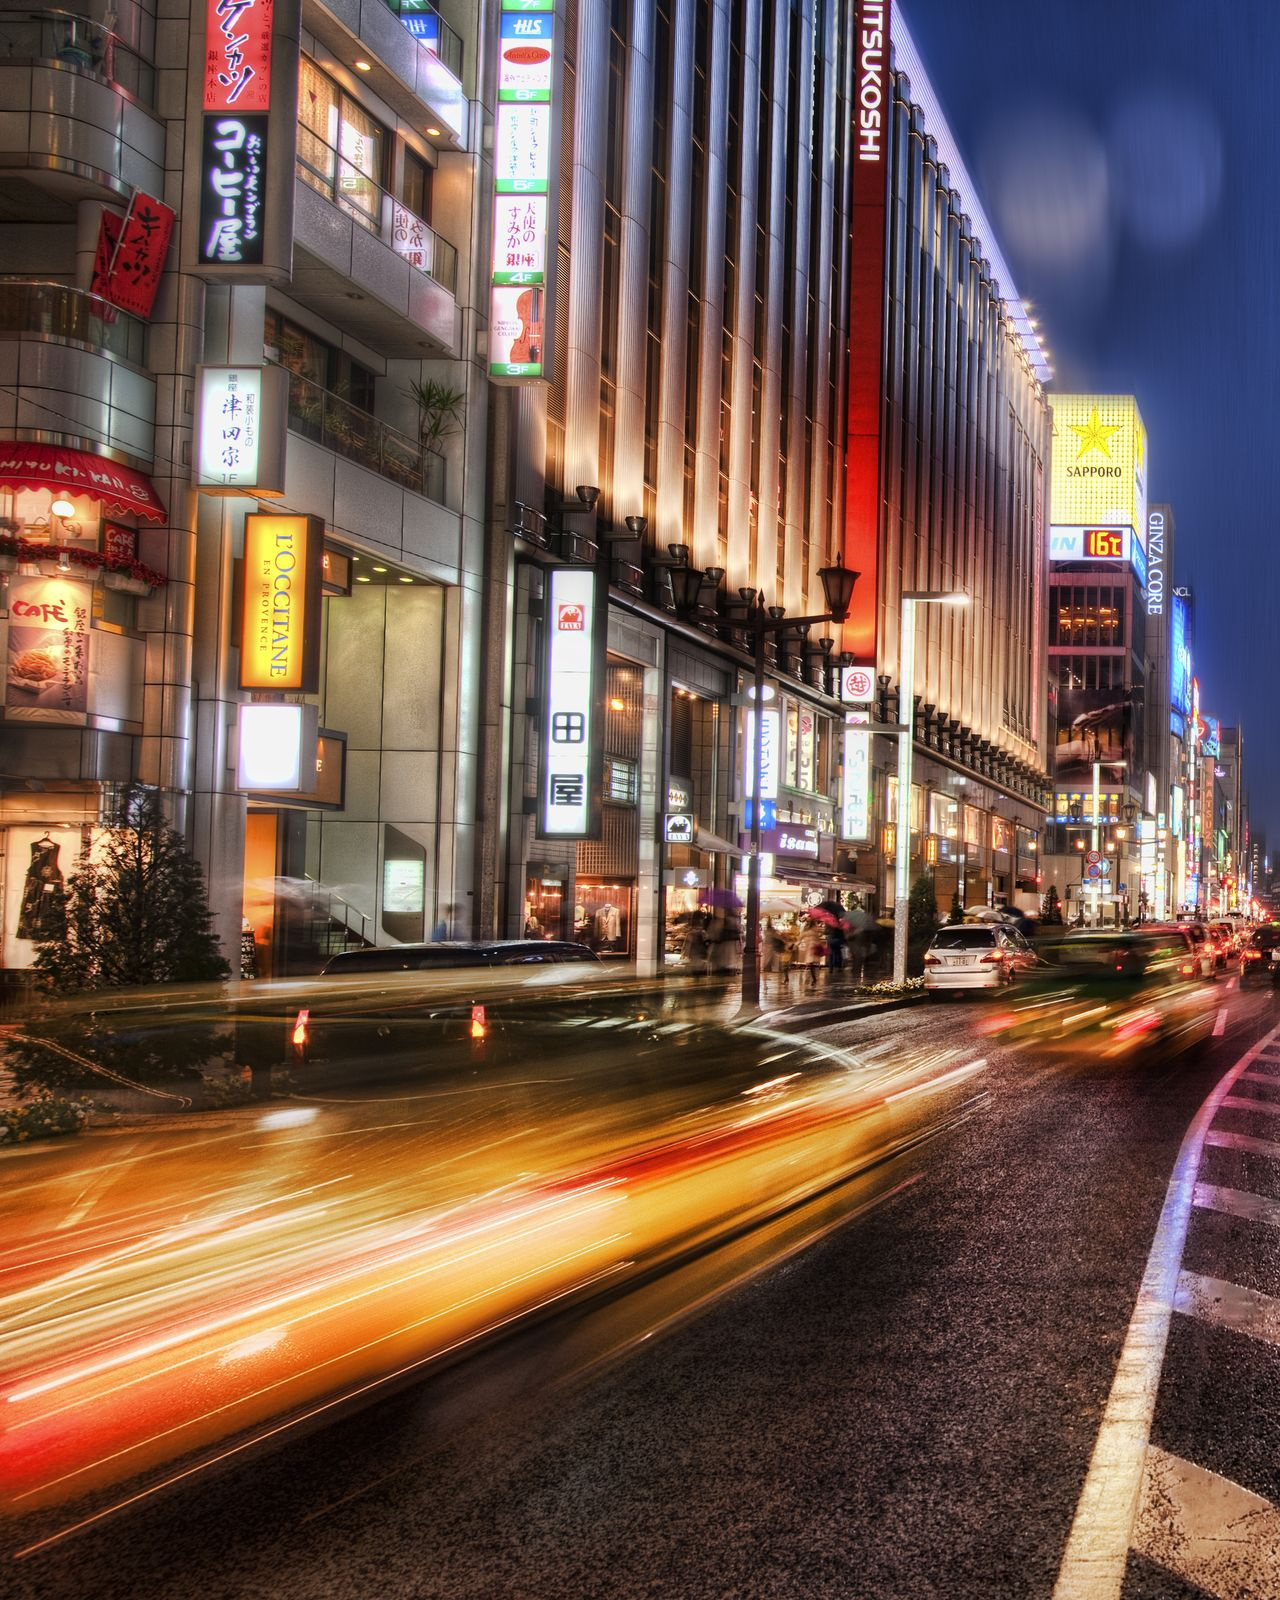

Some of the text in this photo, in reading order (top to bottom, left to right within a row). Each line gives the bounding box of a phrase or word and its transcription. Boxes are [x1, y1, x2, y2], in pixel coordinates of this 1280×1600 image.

[859, 0, 884, 161] ITSUKOSHI
[206, 120, 244, 261] コーヒー屋
[506, 206, 522, 250] すみか
[523, 201, 536, 244] 天使の
[506, 252, 536, 268] 銀座
[1066, 466, 1122, 478] SAPPORO
[259, 560, 271, 652] EN PROVENCE
[270, 534, 296, 677] L'OCCITANE
[1147, 512, 1164, 615] GINZA CORE
[550, 711, 585, 806] 田屋
